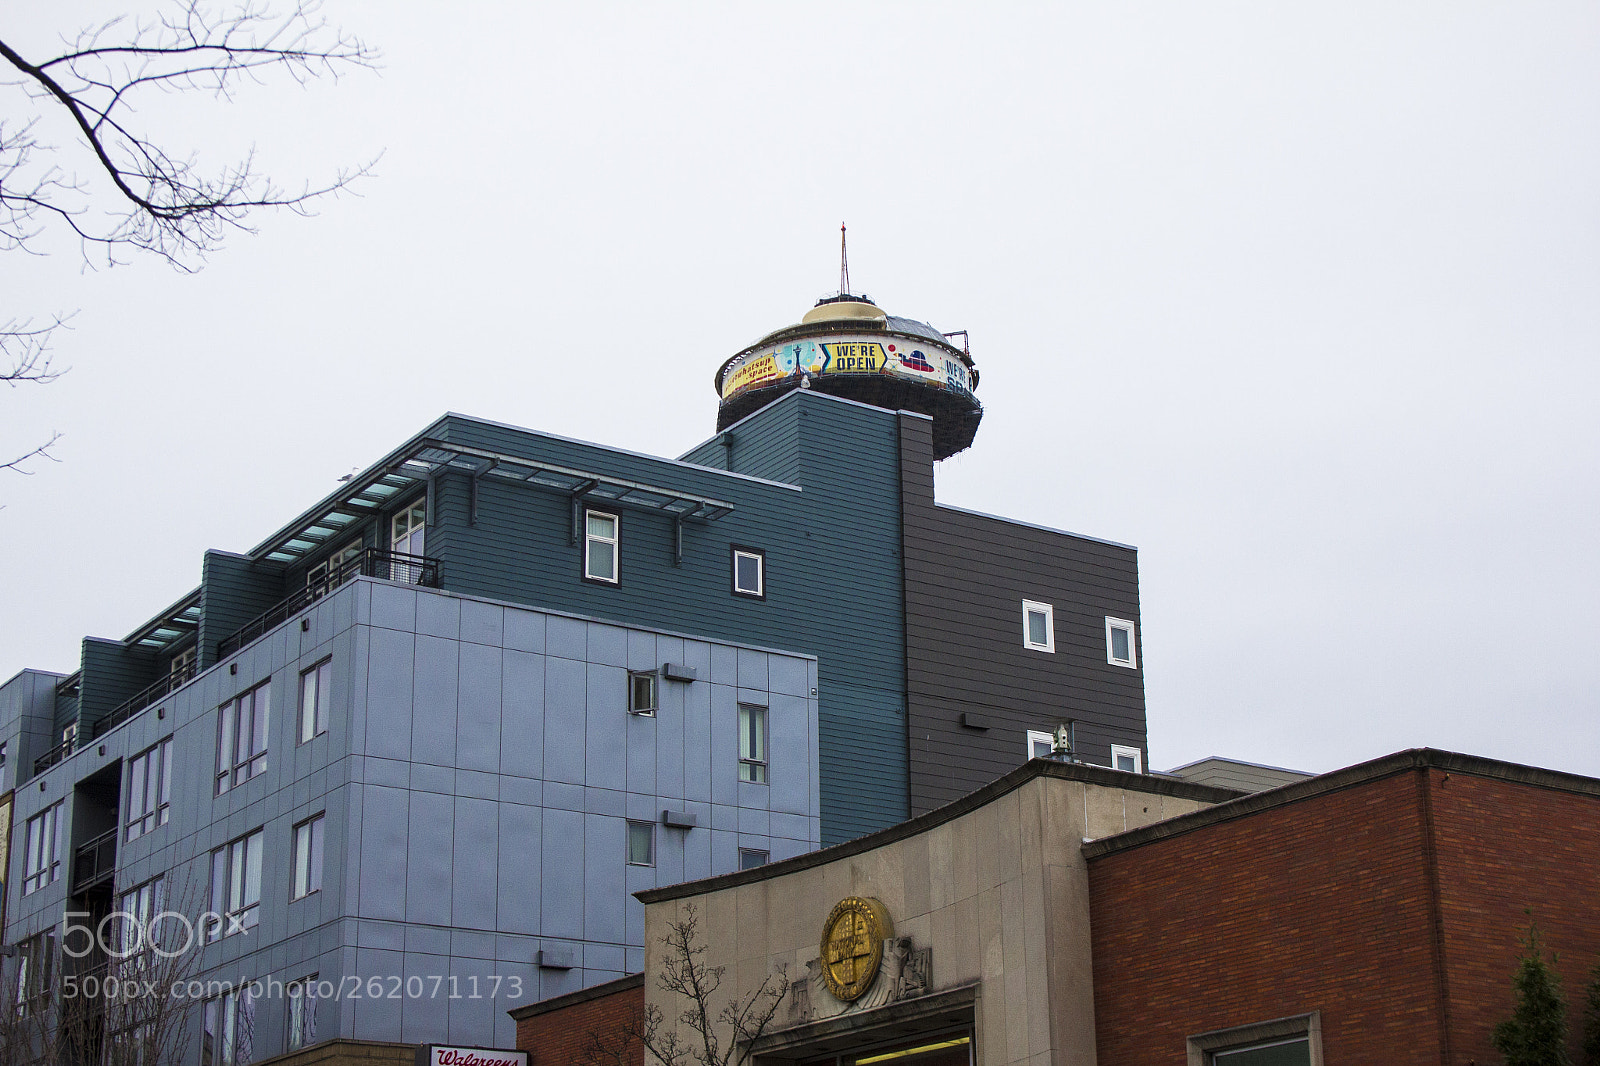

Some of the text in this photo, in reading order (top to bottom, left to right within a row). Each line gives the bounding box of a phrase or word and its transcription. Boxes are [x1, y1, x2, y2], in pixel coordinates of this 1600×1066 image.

[837, 346, 875, 356] WE'RE
[837, 357, 875, 370] OPEN
[437, 1049, 519, 1066] Walgreens
